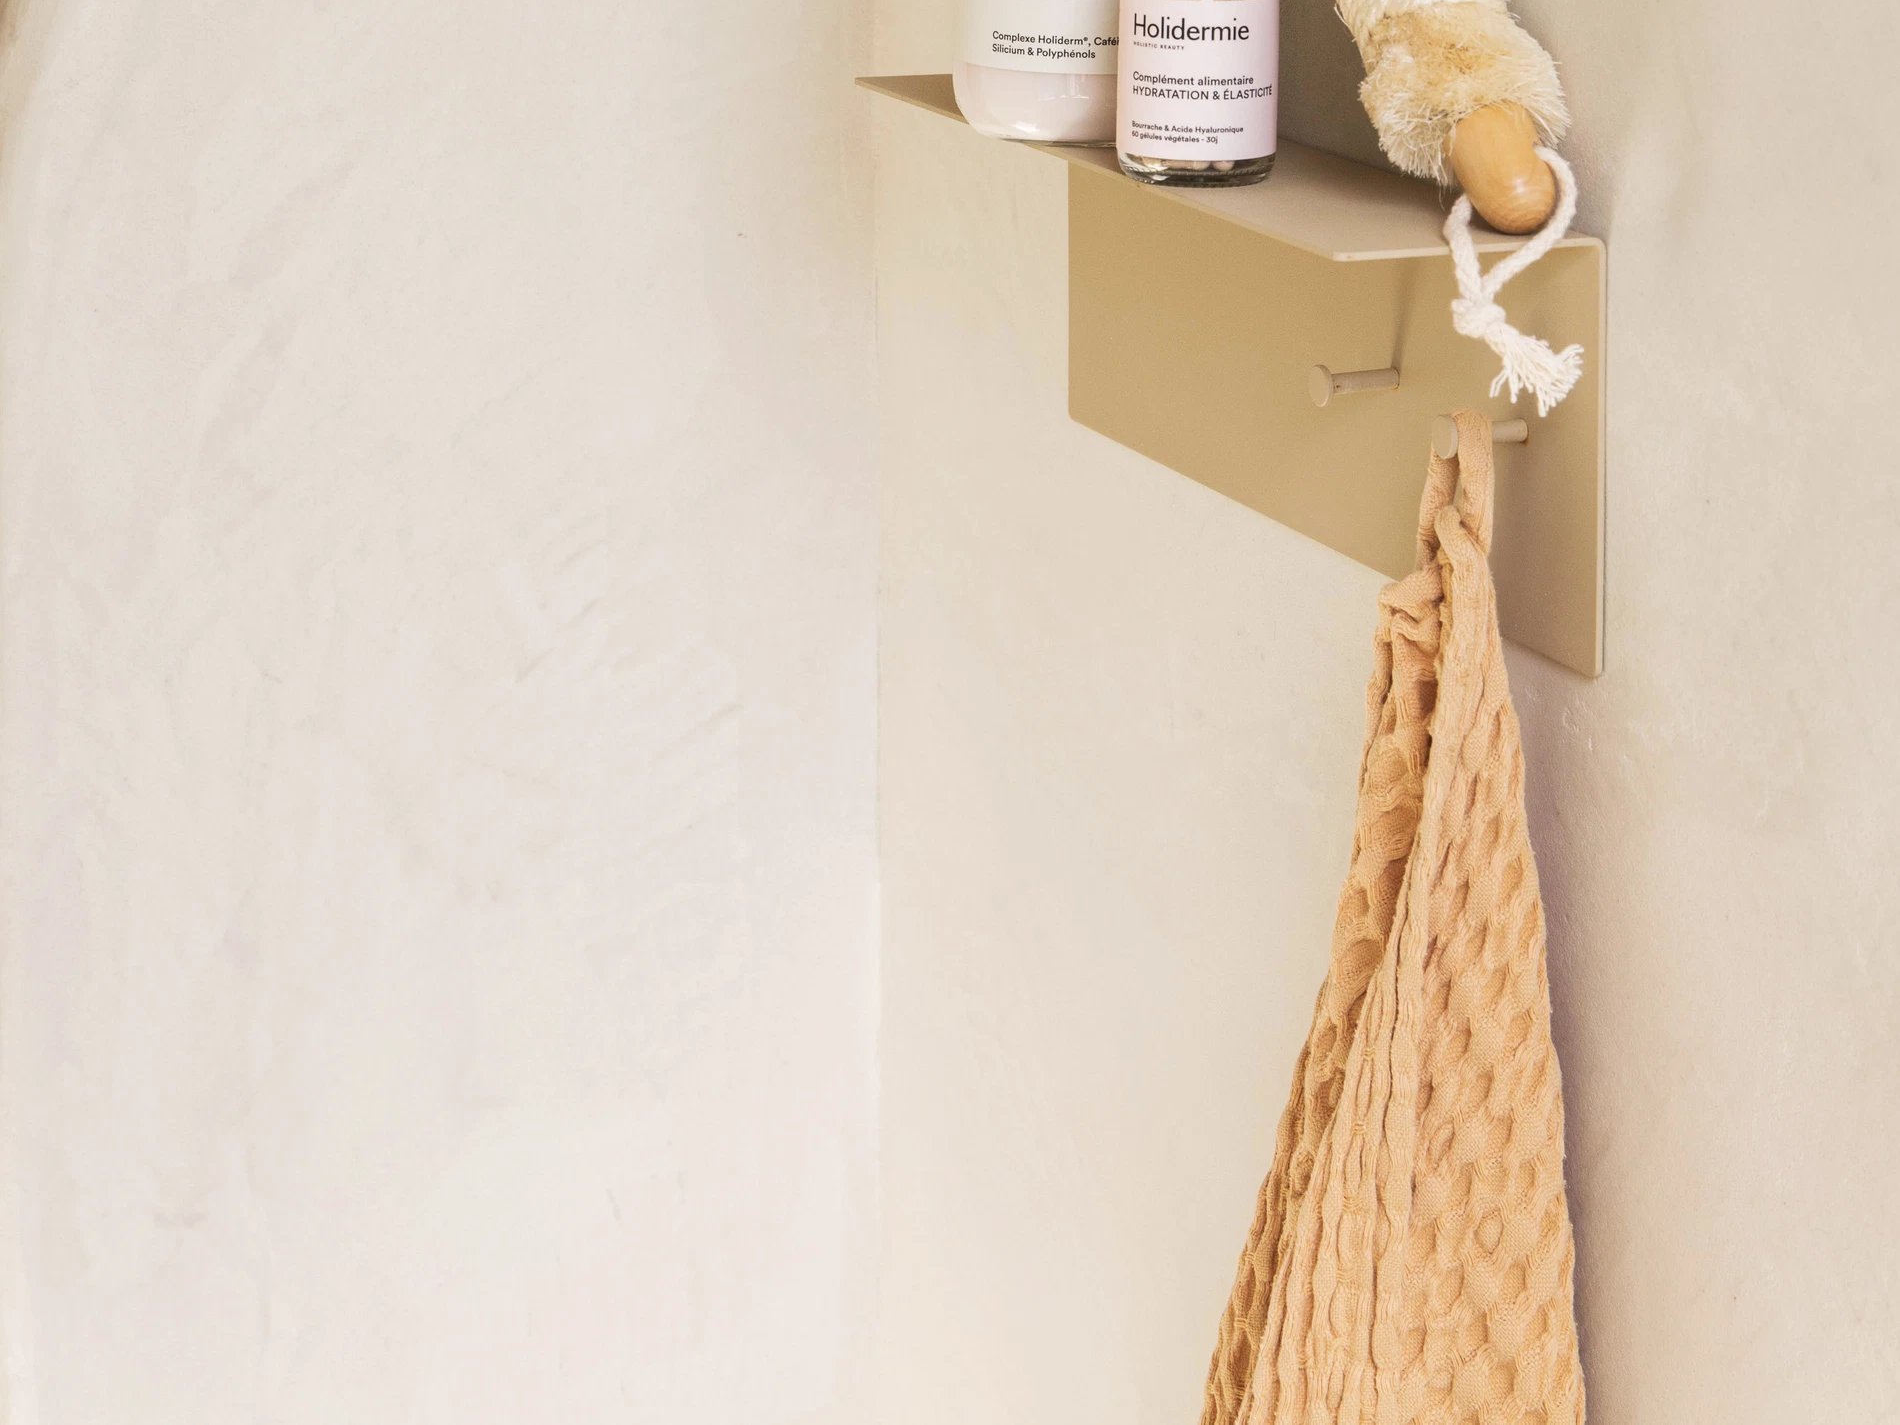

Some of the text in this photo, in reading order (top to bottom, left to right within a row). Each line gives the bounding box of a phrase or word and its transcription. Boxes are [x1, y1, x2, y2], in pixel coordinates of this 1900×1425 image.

[1133, 13, 1250, 41] Holidermie
[992, 31, 1036, 43] Complexe
[1094, 36, 1119, 46] Caféi
[992, 44, 1096, 60] Silicium & Polyphénols
[1133, 71, 1254, 86] Complément alimentaire
[1132, 84, 1272, 100] HYDRATATION & ÉLASTICITÉ
[1132, 121, 1162, 131] Bourrache
[1163, 125, 1170, 133] &
[1195, 126, 1244, 134] Hyaluronique
[1140, 131, 1162, 140] gélules
[1164, 134, 1200, 143] végétales
[1206, 136, 1218, 144] 30j
